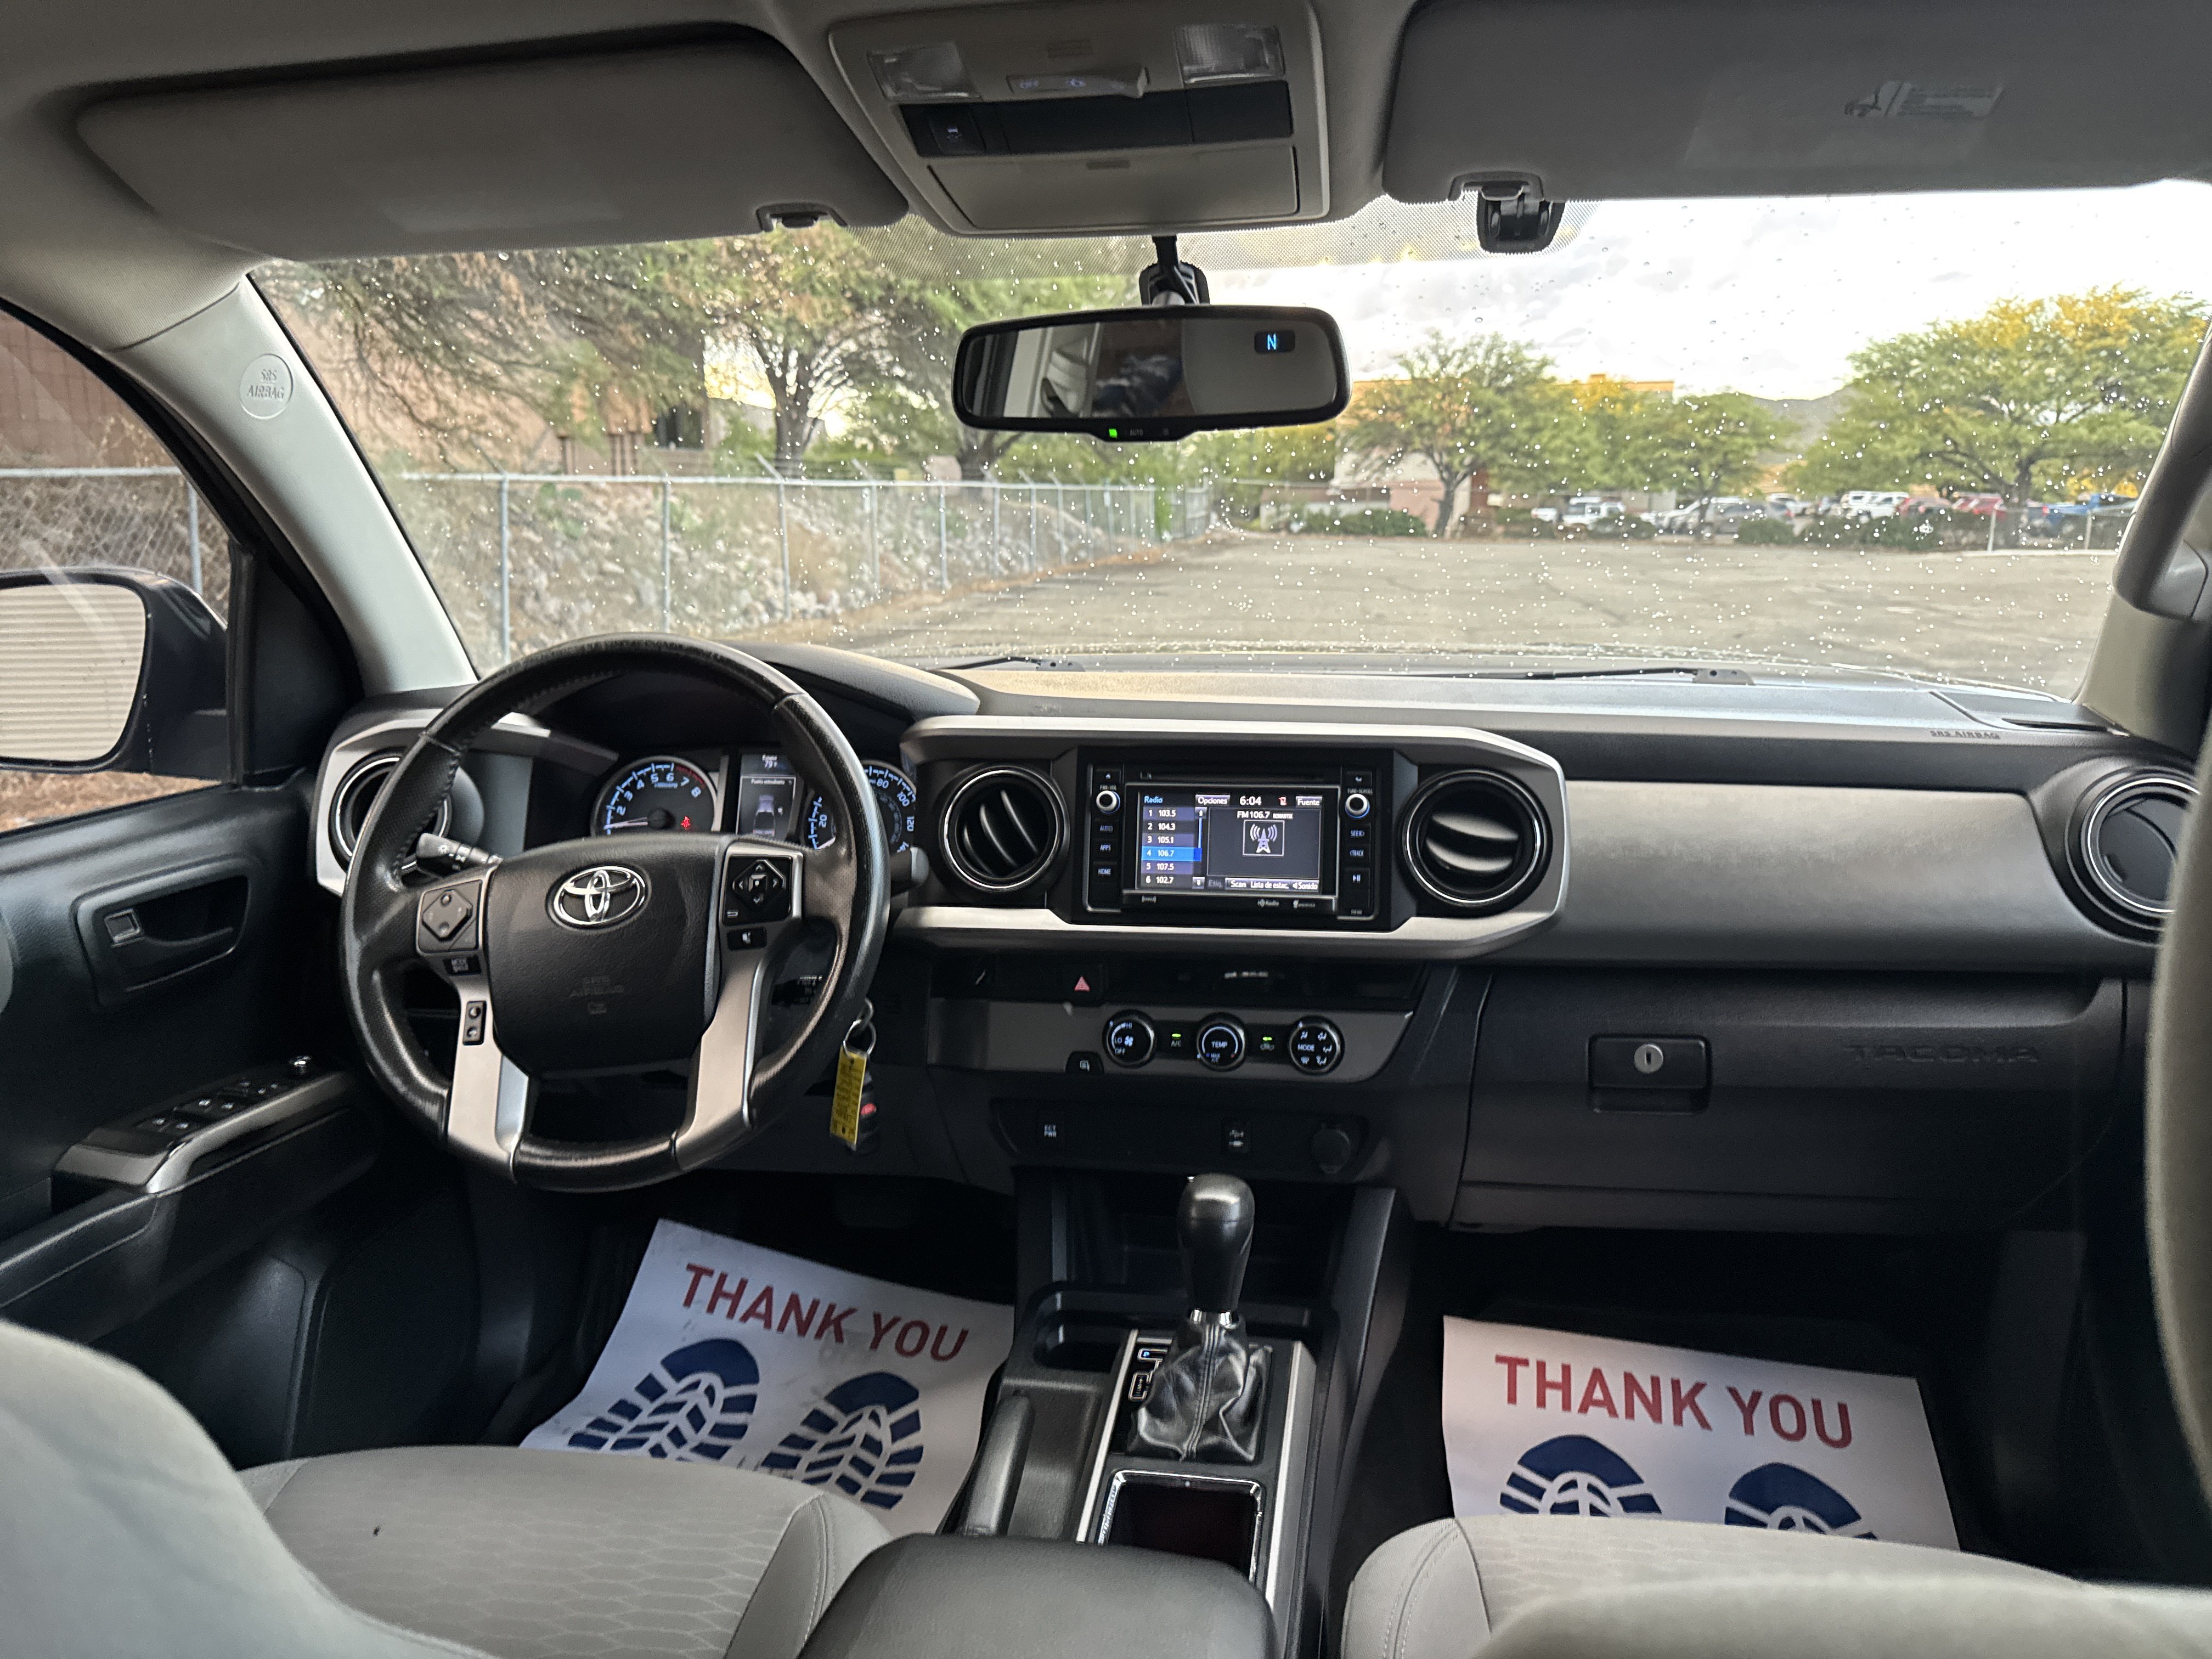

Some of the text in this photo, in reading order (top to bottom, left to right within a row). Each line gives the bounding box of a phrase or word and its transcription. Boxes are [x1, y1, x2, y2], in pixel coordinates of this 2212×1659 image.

[1266, 332, 1278, 351] N
[261, 369, 277, 381] SRS
[247, 385, 284, 399] AIRBAG
[1955, 731, 2001, 740] AIRBAG
[650, 773, 658, 783] 5
[666, 772, 675, 782] 6
[680, 776, 690, 787] 7
[636, 779, 645, 790] 4
[877, 778, 889, 788] 80
[623, 791, 633, 801] 3
[691, 787, 701, 798] 8
[896, 792, 910, 807] 100
[1198, 797, 1228, 805] Opciones
[1240, 796, 1262, 805] 6:04
[616, 806, 626, 816] 2
[819, 814, 827, 828] 20
[896, 842, 909, 853] 14
[1100, 844, 1111, 852] APPS
[1171, 1040, 1182, 1048] A/C
[1297, 1043, 1315, 1052] MODE
[1843, 1044, 2039, 1064] TACOMA
[682, 1263, 969, 1362] THANK YOU
[1494, 1354, 1853, 1449] THANK YOU
